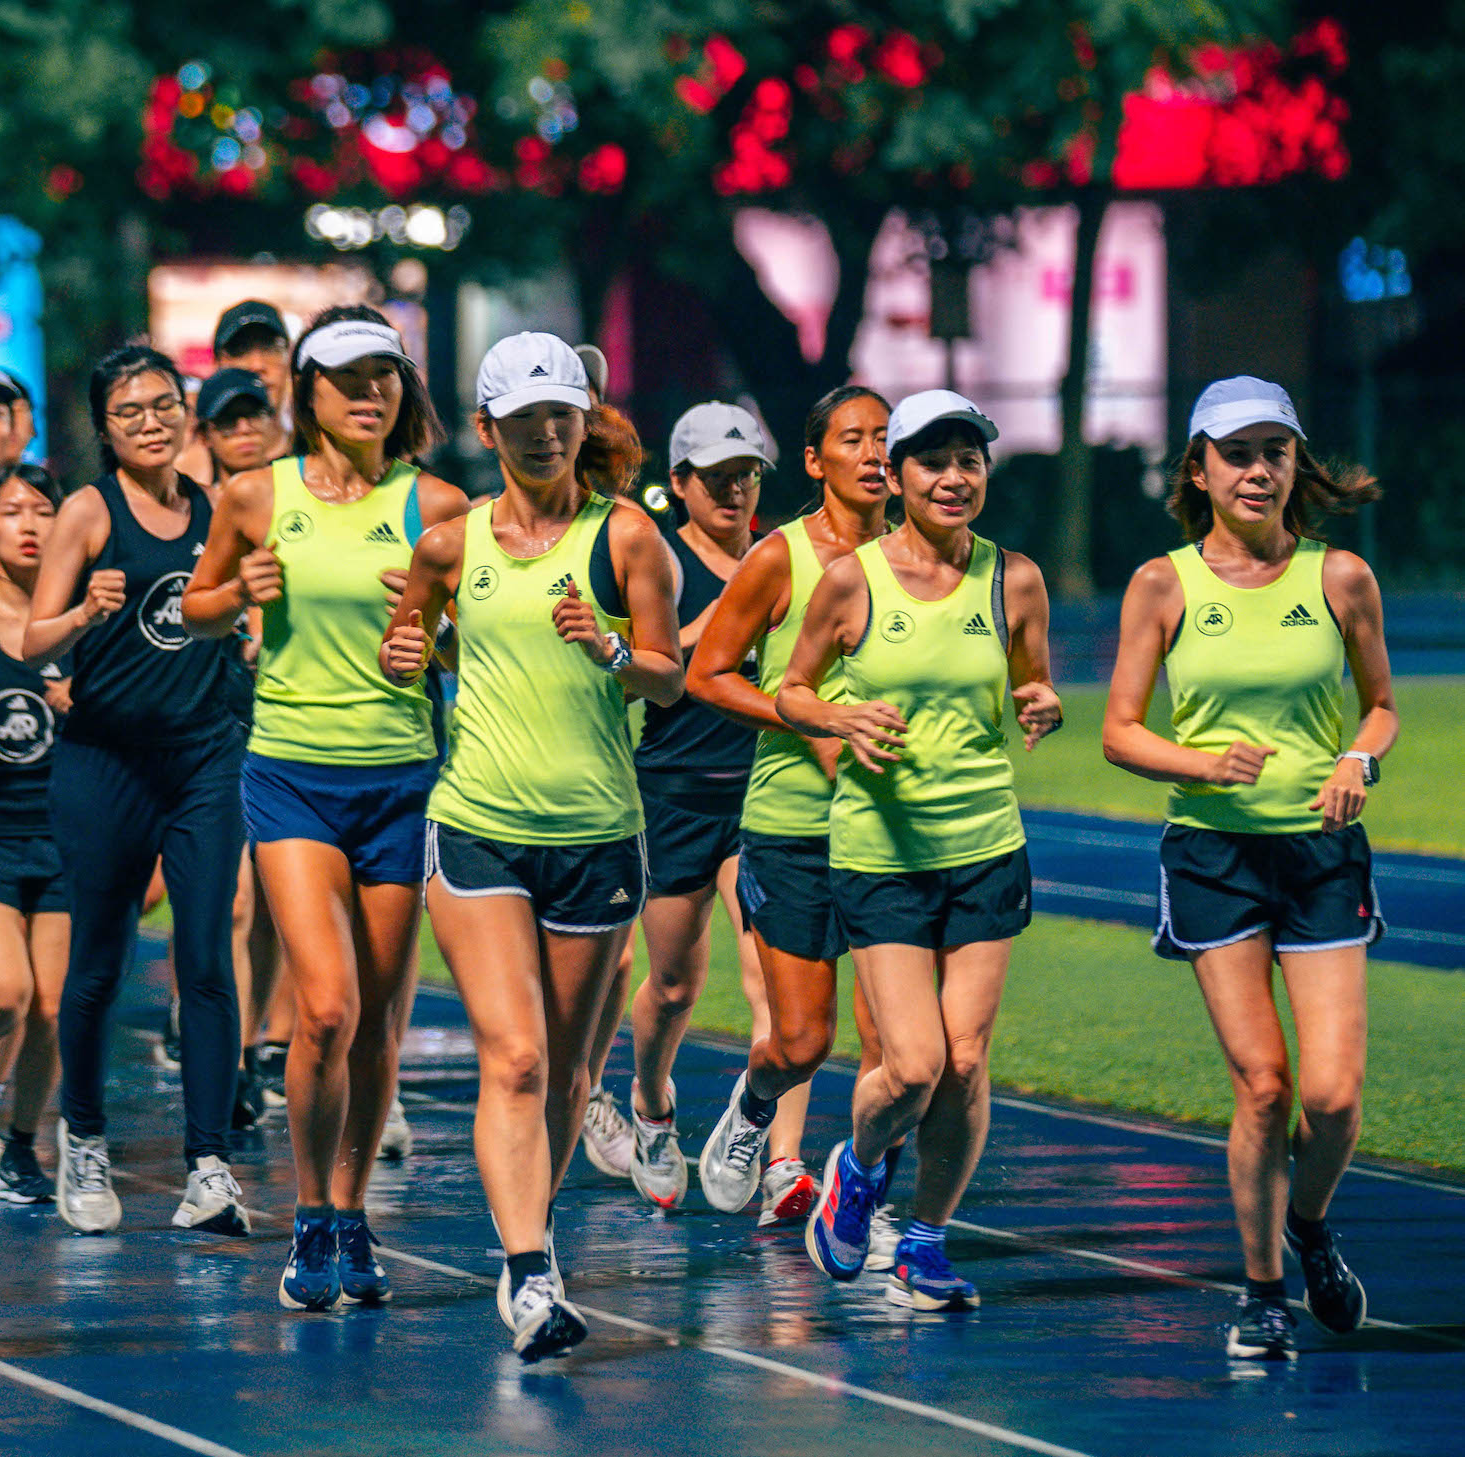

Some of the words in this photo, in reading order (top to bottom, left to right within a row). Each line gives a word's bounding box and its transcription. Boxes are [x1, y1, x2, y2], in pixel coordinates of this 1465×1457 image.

[547, 588, 583, 597] adis
[153, 595, 184, 625] A
[1280, 618, 1319, 627] adidas
[963, 627, 992, 636] adidas
